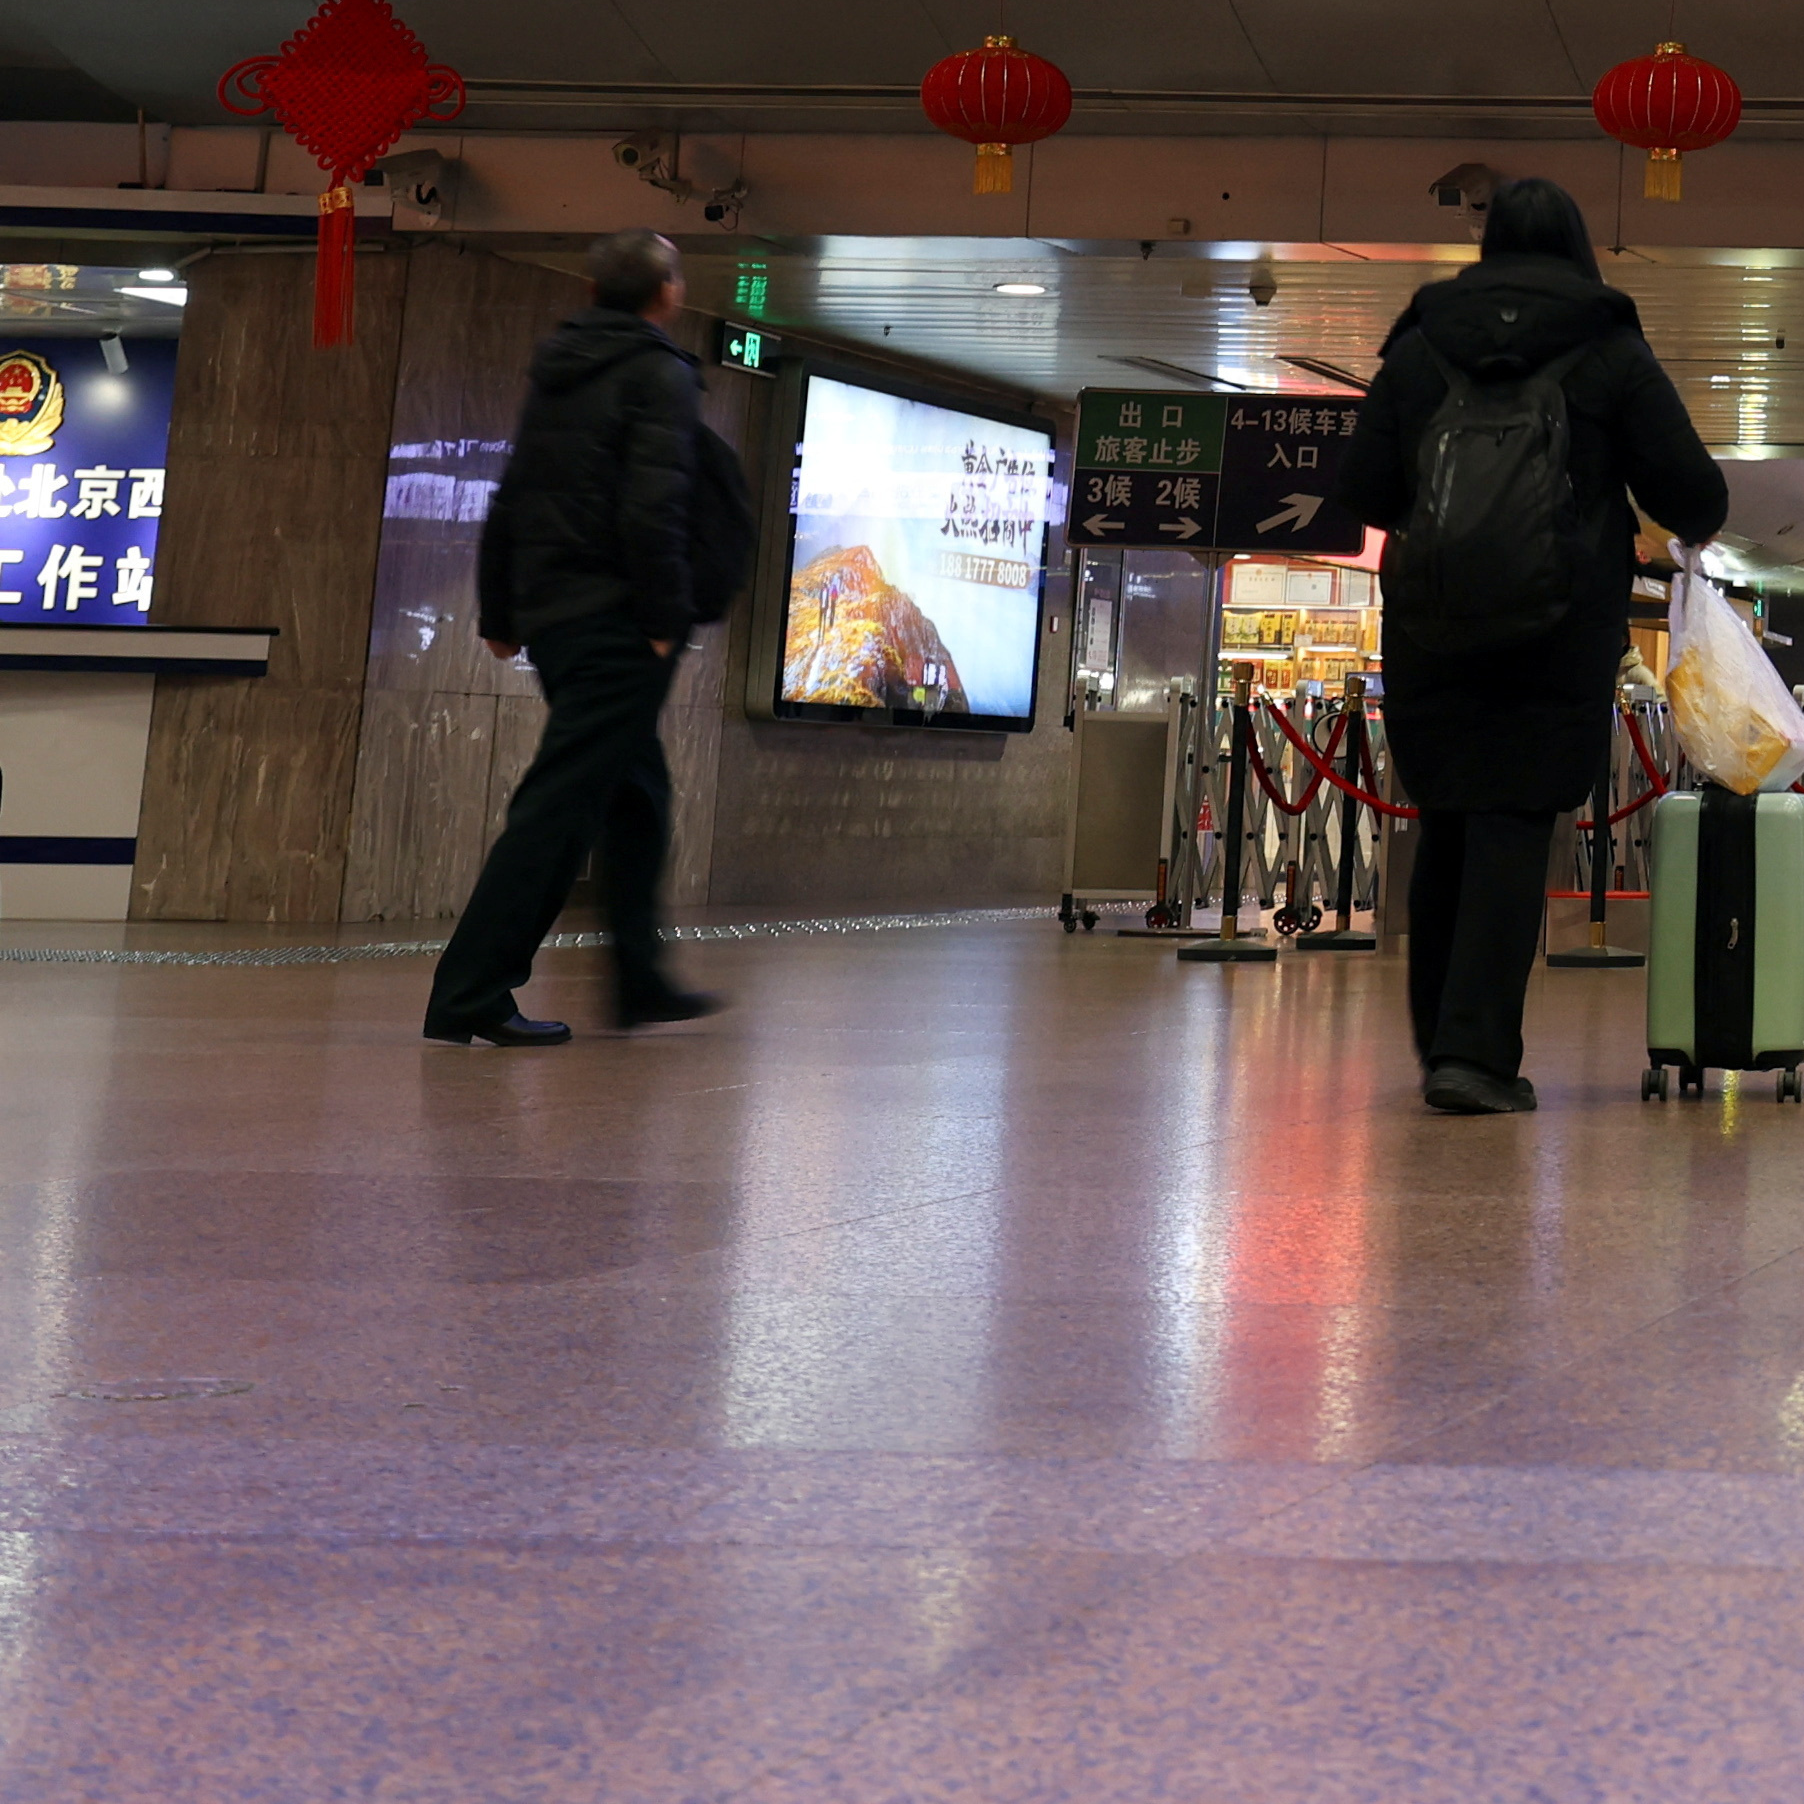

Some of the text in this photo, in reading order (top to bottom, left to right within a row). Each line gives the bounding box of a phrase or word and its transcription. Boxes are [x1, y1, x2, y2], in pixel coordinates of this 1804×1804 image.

[1094, 436, 1201, 466] 旅客止步
[1267, 443, 1318, 469] 入口
[0, 463, 166, 520] 北京西
[1087, 474, 1201, 510] 3候 2候
[997, 560, 1027, 587] 8008
